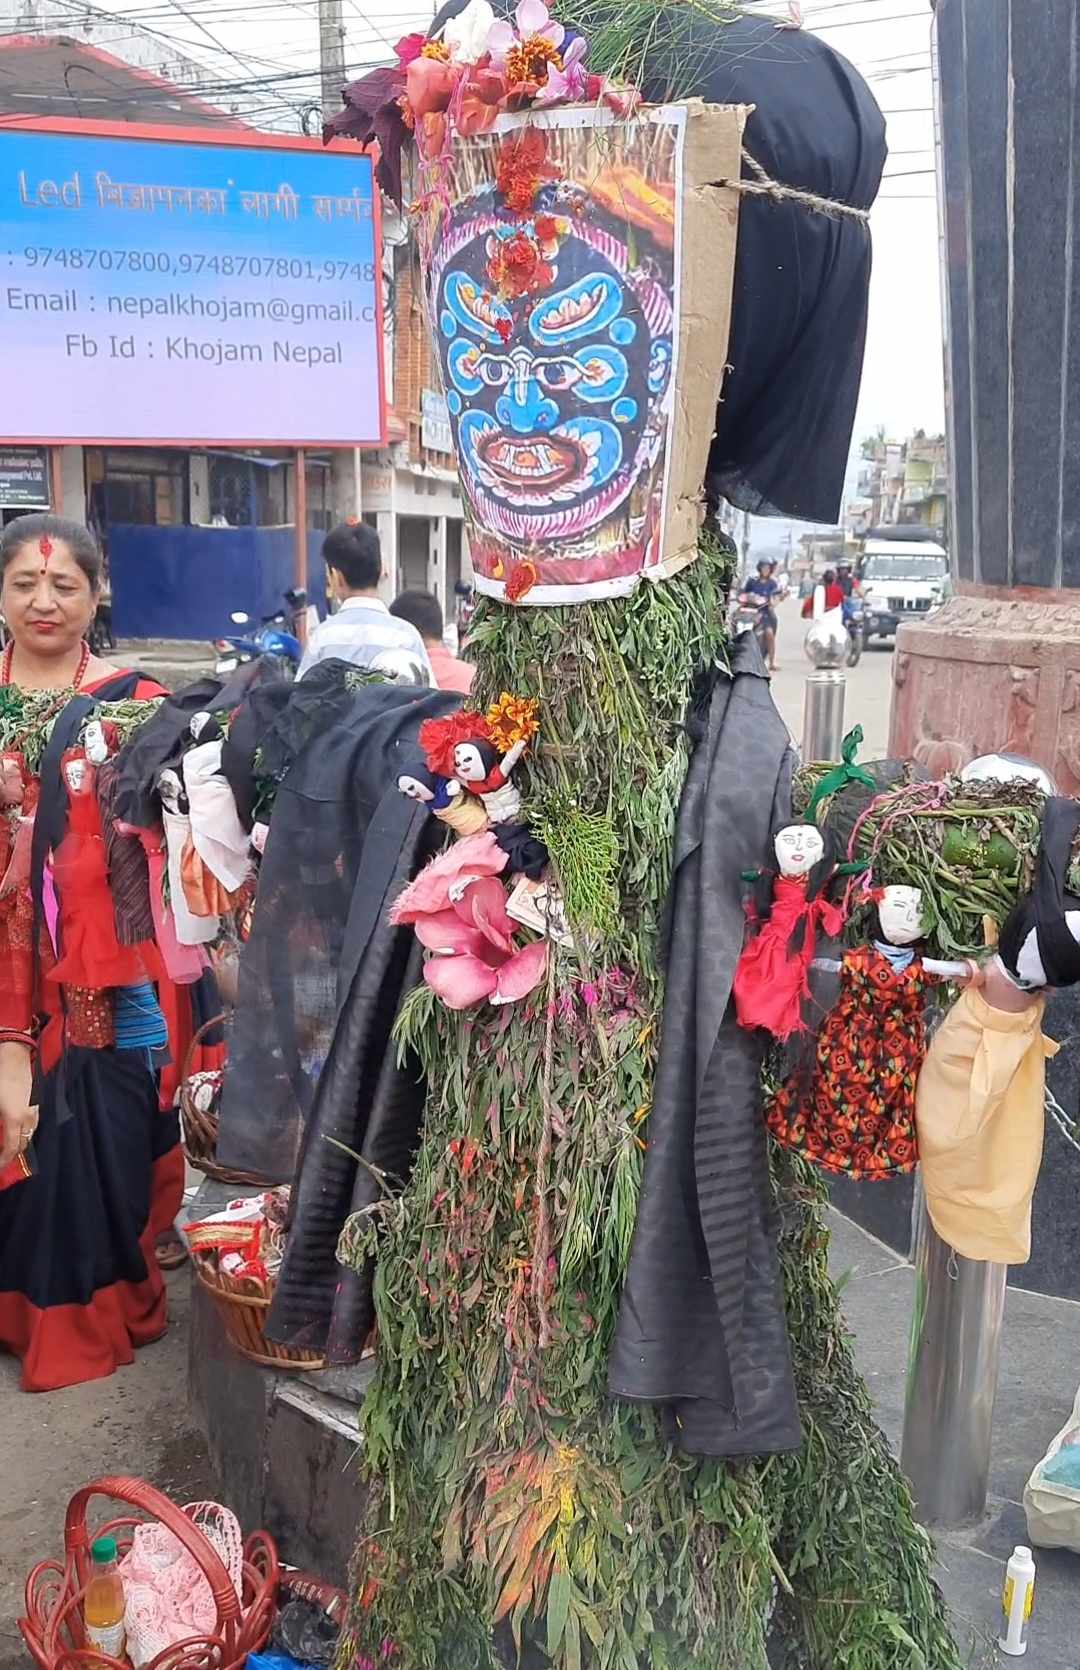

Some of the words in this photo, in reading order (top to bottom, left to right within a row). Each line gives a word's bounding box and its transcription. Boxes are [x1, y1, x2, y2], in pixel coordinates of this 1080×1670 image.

[19, 169, 81, 208] Led
[6, 287, 77, 312] Email
[107, 292, 377, 325] nepalkhojam@gmail.c
[66, 333, 98, 358] Fb
[109, 335, 136, 359] Id
[166, 336, 263, 366] Khojam
[273, 340, 343, 368] Nepal
